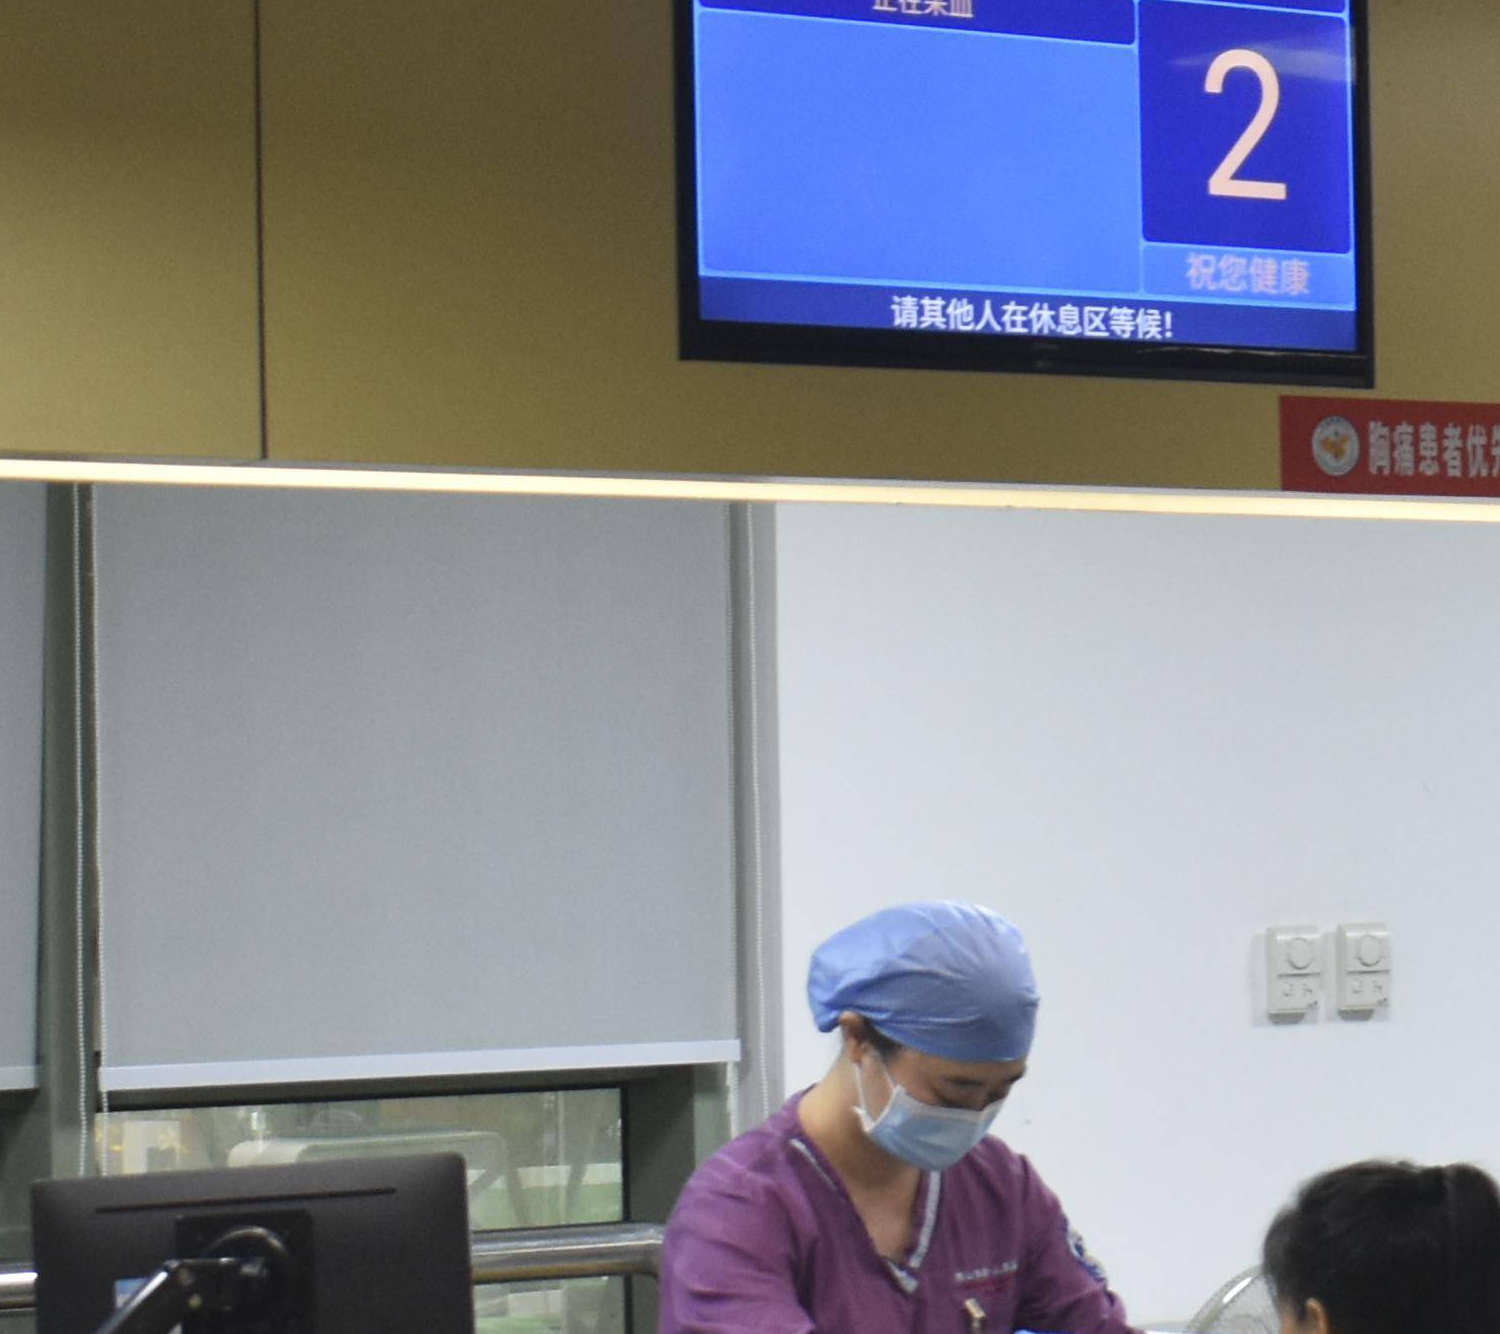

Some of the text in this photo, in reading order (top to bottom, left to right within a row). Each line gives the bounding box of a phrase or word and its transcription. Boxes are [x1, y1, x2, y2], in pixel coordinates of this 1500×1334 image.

[1204, 49, 1287, 200] 2
[1186, 253, 1310, 296] 祝您健康
